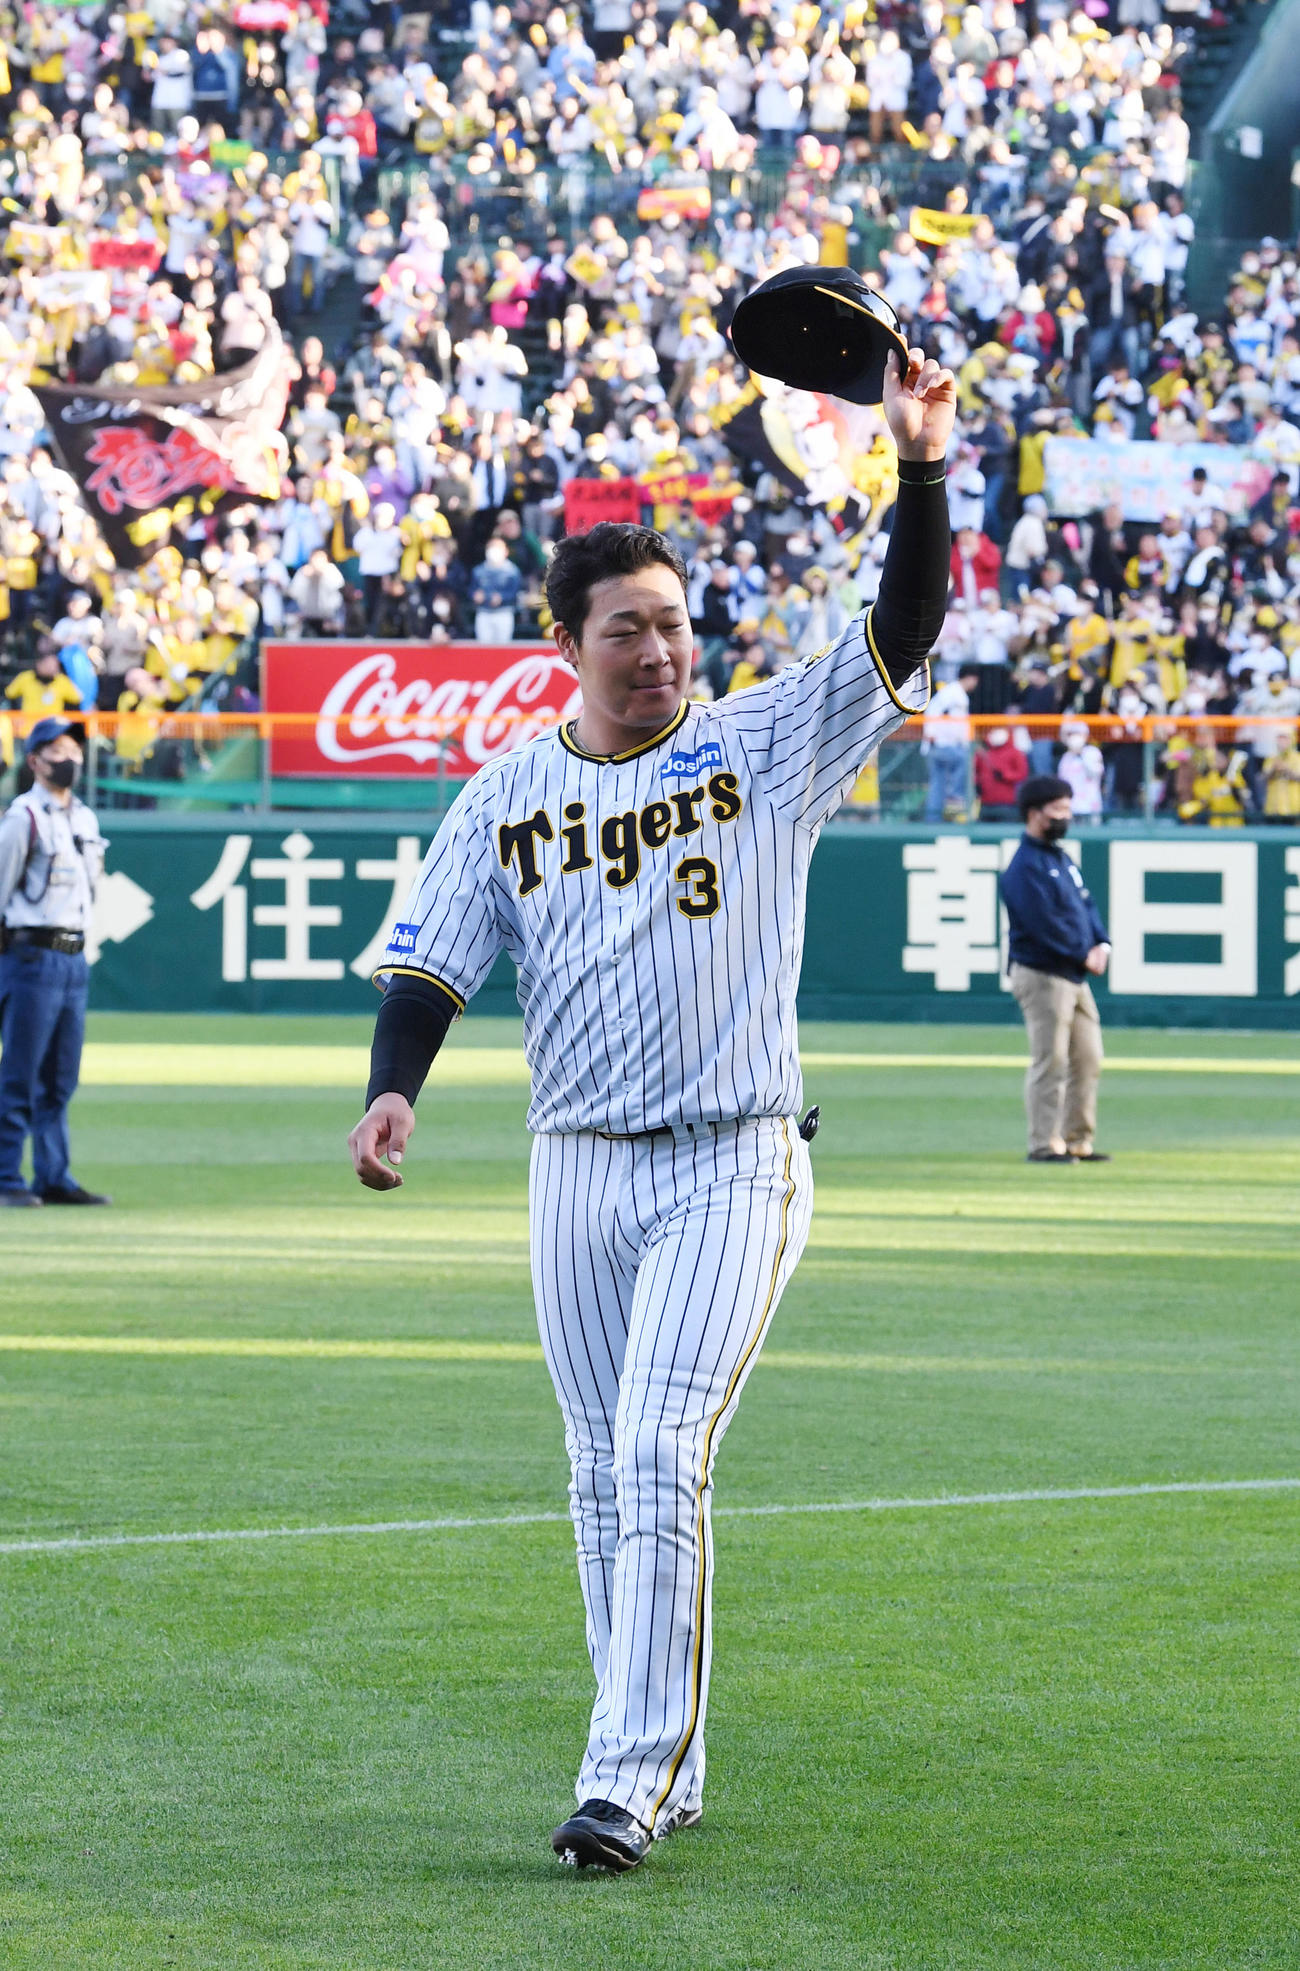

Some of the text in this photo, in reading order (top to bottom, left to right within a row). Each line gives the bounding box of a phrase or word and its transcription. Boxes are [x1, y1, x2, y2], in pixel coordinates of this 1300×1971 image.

[498, 771, 743, 898] Tigers
[675, 855, 721, 920] 3
[902, 835, 1300, 997] 朝日
